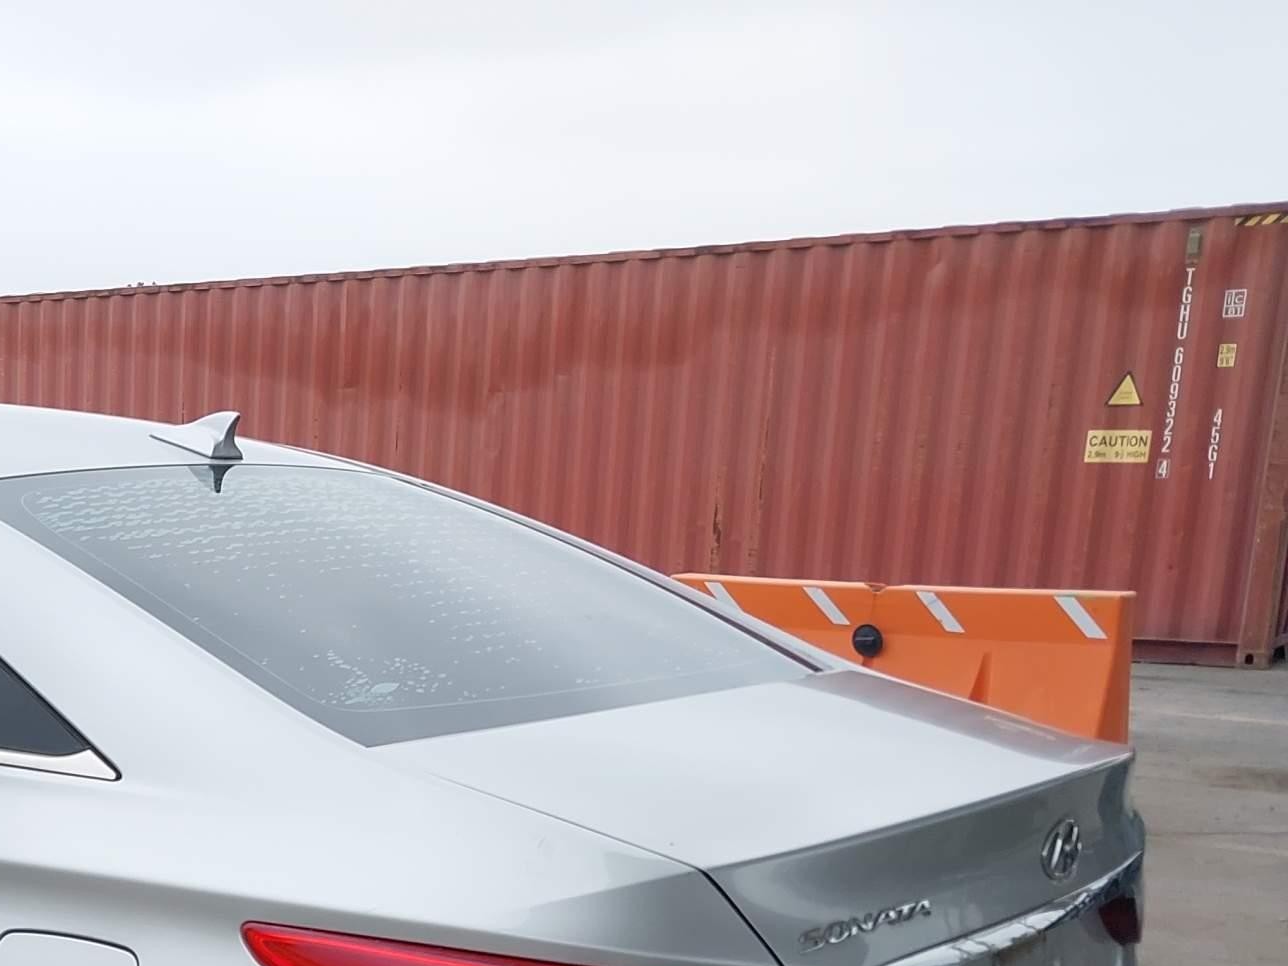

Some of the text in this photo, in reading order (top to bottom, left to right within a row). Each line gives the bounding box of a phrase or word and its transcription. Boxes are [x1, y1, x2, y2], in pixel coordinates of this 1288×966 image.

[1158, 268, 1196, 478] TGHU 609322 4
[1089, 435, 1148, 447] CAUTION
[1208, 409, 1223, 479] 45G1
[799, 900, 931, 954] SONATA
